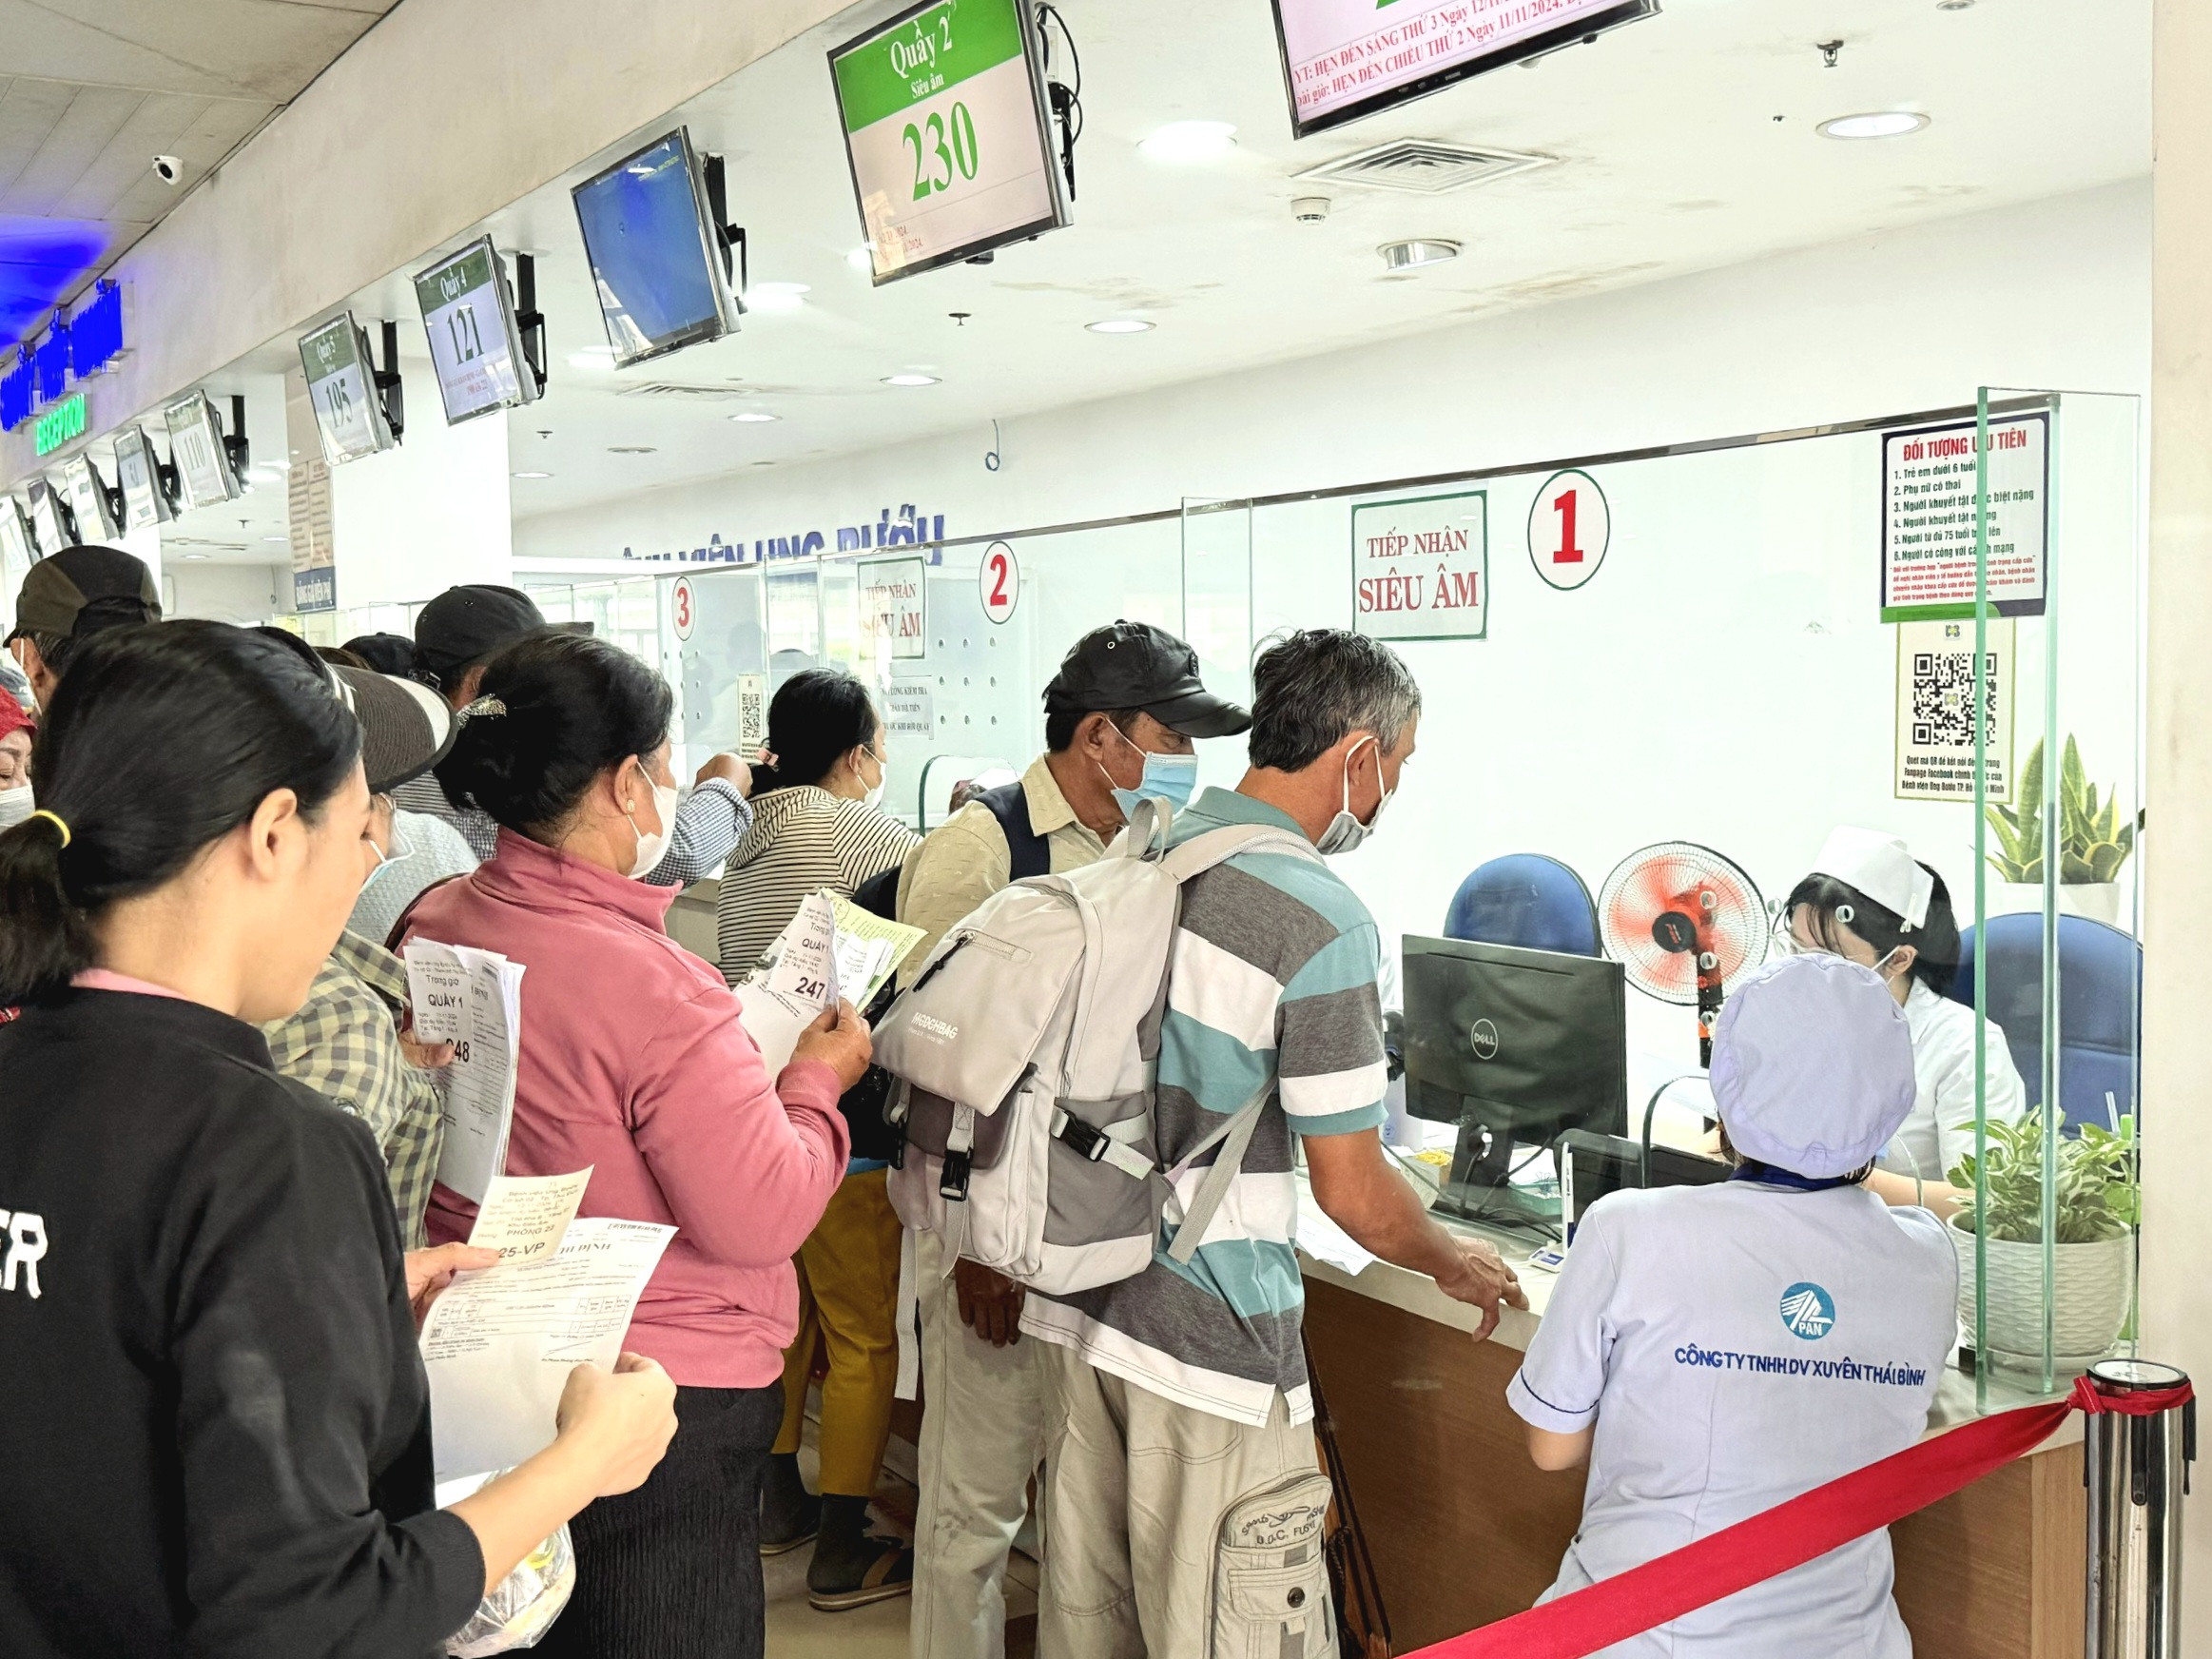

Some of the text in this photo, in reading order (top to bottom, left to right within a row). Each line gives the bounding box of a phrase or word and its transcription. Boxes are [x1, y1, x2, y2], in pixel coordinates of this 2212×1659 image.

[890, 16, 953, 79] Quầy 2
[1315, 55, 1339, 77] HẸN
[1340, 42, 1365, 67] ĐẾN
[1367, 32, 1399, 56] SÁNG
[1401, 13, 1428, 41] THỨ
[1430, 14, 1438, 29] 3
[1440, 6, 1467, 27] Ngày
[1332, 71, 1356, 93] HẸN
[1359, 60, 1384, 84] ĐẾN
[1386, 44, 1425, 73] CHIỀU
[1426, 29, 1454, 57] THỨ
[1458, 30, 1465, 46] 2
[1466, 20, 1496, 43] Ngày
[910, 72, 945, 99] Siêu âm
[902, 101, 979, 202] 230
[460, 265, 468, 287] 4
[447, 303, 485, 366] 121
[325, 378, 353, 428] 195
[36, 393, 86, 457] RECEPTION
[1903, 437, 1923, 461] ĐỐI
[1927, 437, 1969, 460] TƯỢNG
[1997, 427, 2027, 450] TIÊN
[1894, 470, 1902, 479] 1.
[1904, 466, 1916, 478] Trẻ
[1918, 468, 1931, 477] em
[1952, 463, 1958, 473] 6
[1960, 459, 1976, 473] tuổi
[1893, 478, 1961, 497] 2. Phụ nữ có thai
[1893, 489, 2034, 513] 3. Người khuyết tật đc biệt nặng
[1553, 489, 1584, 564] 1
[1893, 511, 1997, 528] 4. Người khuyết tật nng
[1893, 535, 1901, 545] 5.
[1902, 533, 1923, 545] Người
[1924, 532, 1931, 542] từ
[1933, 530, 1943, 541] đủ
[1945, 530, 1953, 540] 75
[1955, 526, 1969, 539] tuổi
[1989, 525, 2001, 537] lên
[1367, 524, 1469, 558] TIẾP NHẬN
[1902, 548, 1923, 561] Người
[1924, 547, 1933, 559] có
[1934, 546, 1953, 558] công
[1955, 545, 1967, 556] với
[1969, 543, 1991, 556] cáh
[1993, 543, 2015, 556] mạng
[888, 578, 917, 602] NHẬN
[989, 554, 1007, 607] 2
[1359, 563, 1479, 614] SIÊU ÂM
[676, 586, 689, 628] 3
[899, 605, 922, 637] ÂM
[428, 991, 456, 1008] QUẦY
[794, 976, 826, 1000] 247
[1473, 1032, 1496, 1045] DELL
[1798, 1321, 1823, 1337] PAN
[1674, 1342, 1927, 1387] CÔNG TY TNHH DV XUYÊN THÁI BÌNH
